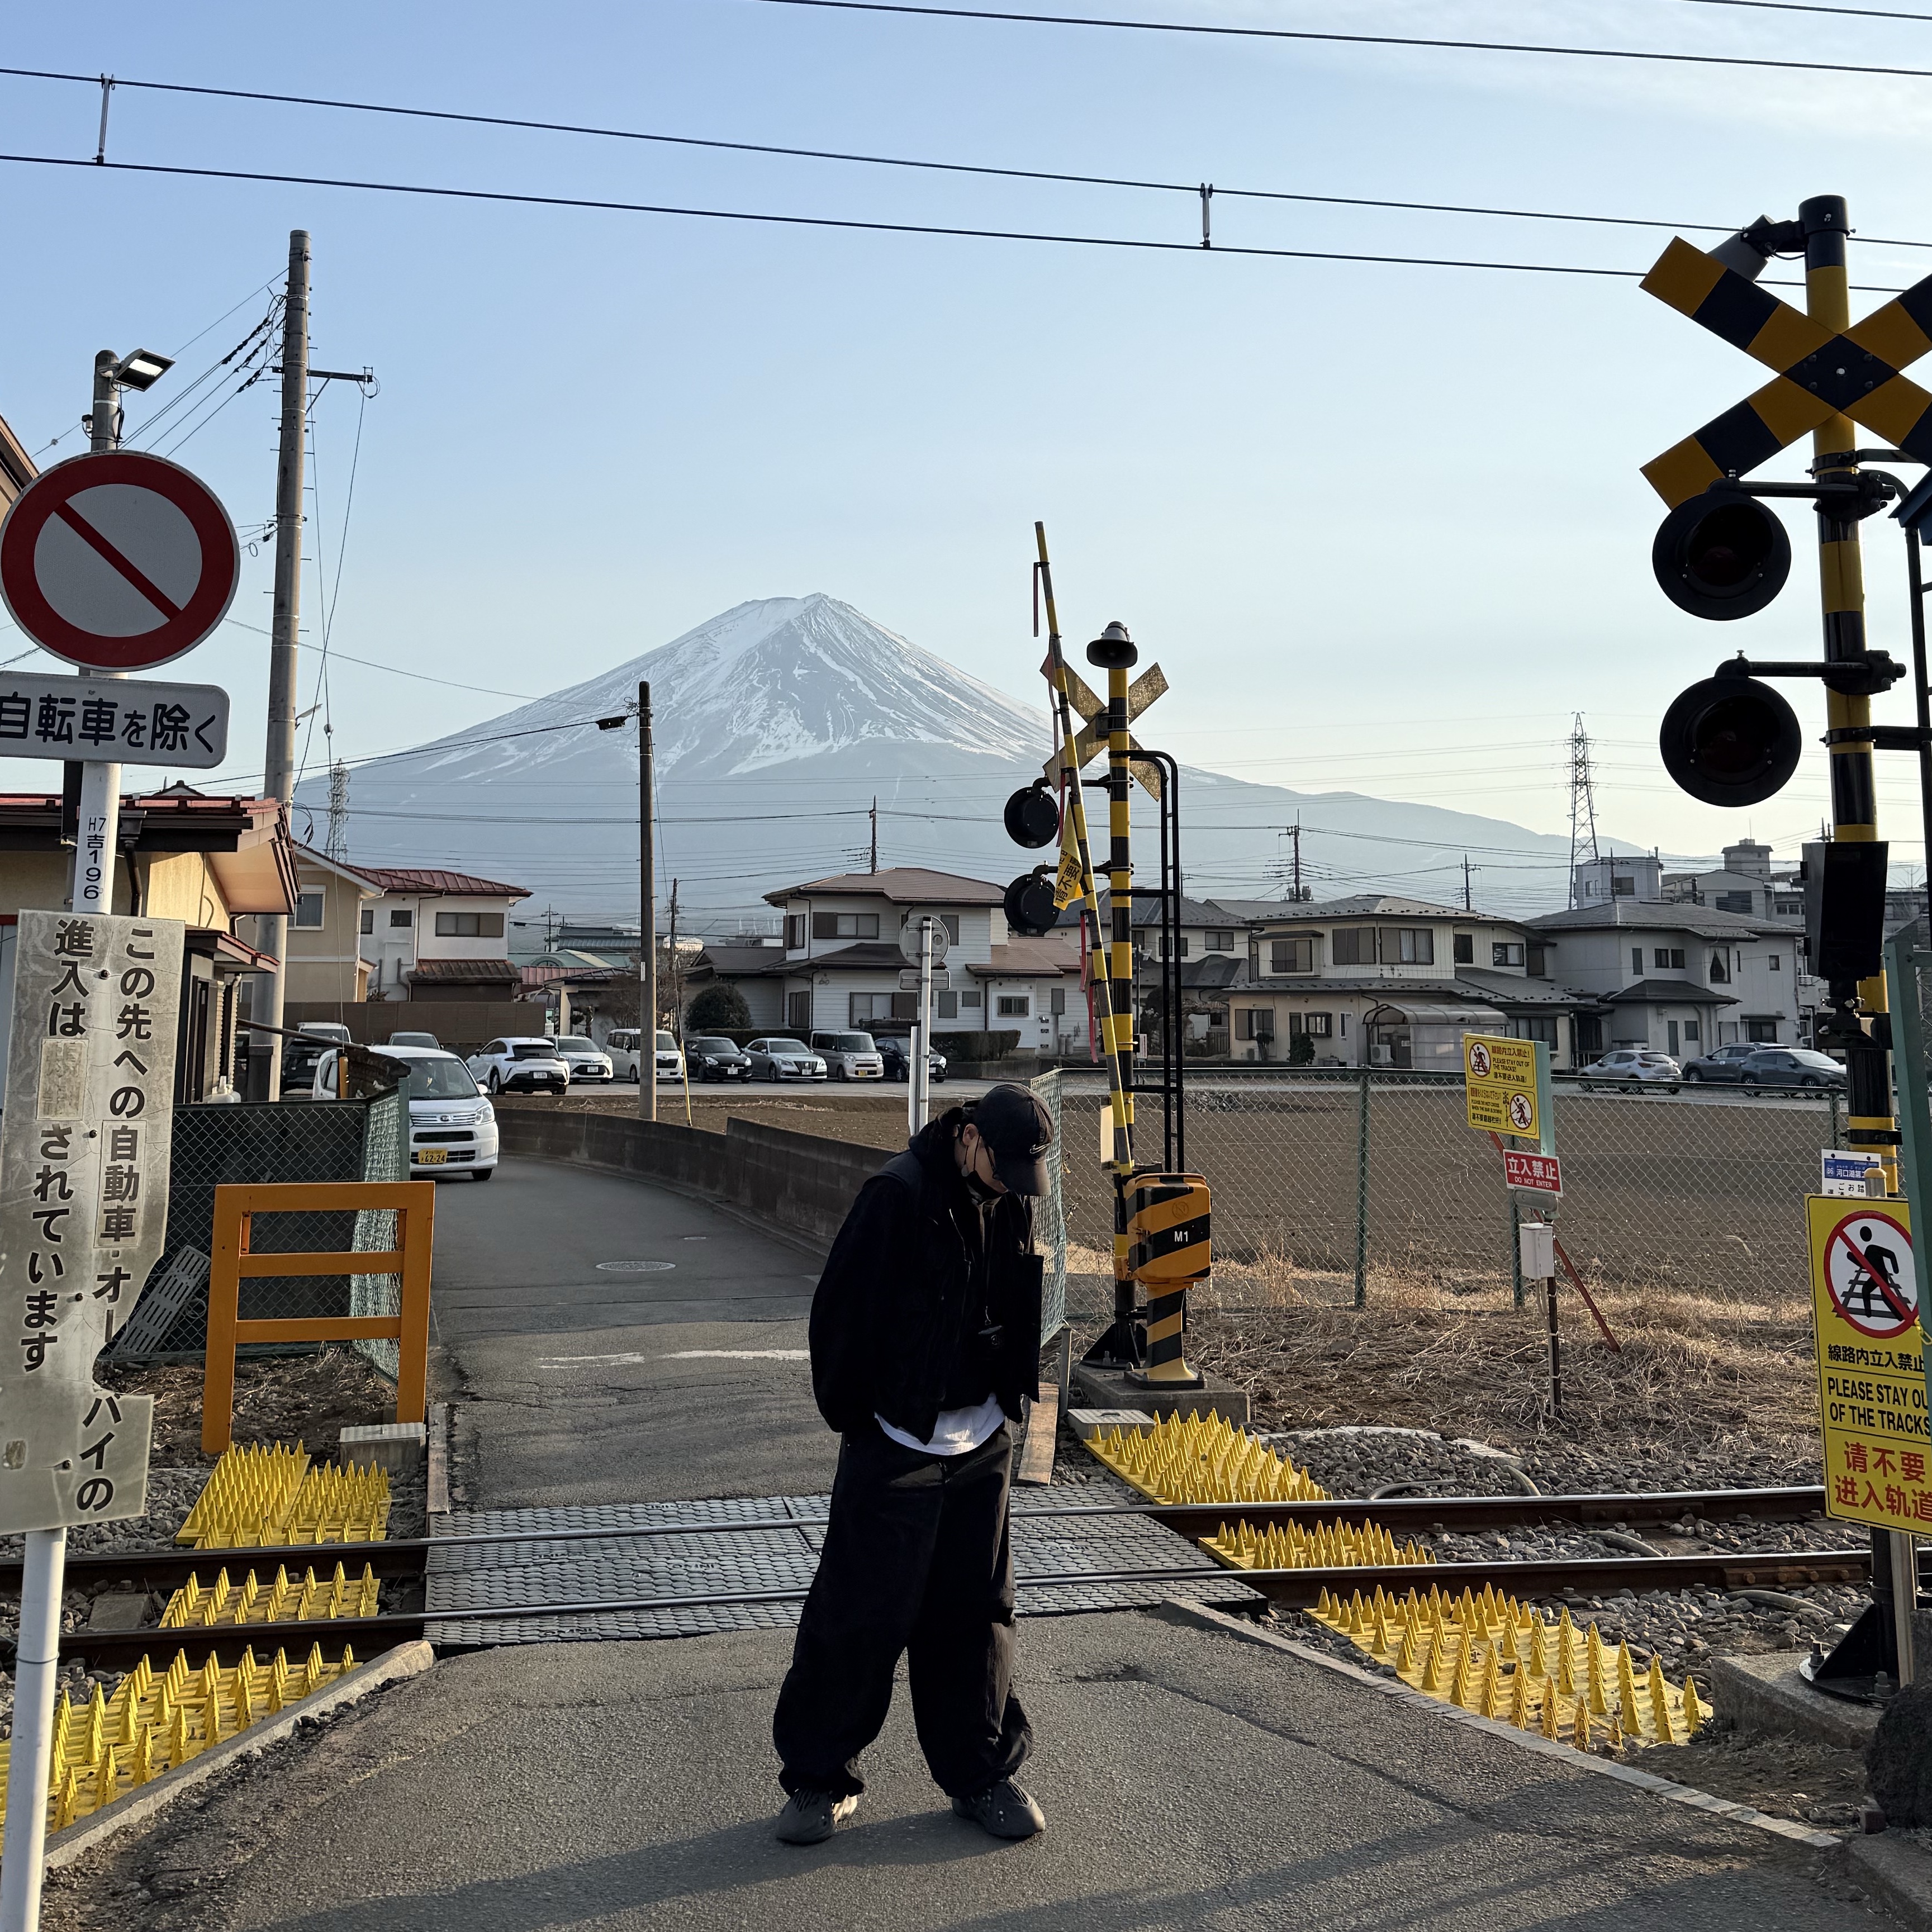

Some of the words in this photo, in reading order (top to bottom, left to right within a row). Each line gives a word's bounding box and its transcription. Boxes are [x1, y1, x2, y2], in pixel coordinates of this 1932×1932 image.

[0, 691, 216, 753] 自転車を除く
[88, 817, 107, 832] H7
[1508, 1157, 1557, 1180] 立入禁止
[1536, 1180, 1553, 1188] ENTER
[1174, 1231, 1188, 1242] M1
[1827, 1344, 1925, 1373] 線路内立入禁止
[1827, 1376, 1874, 1402] PLEASE
[1876, 1384, 1908, 1407] STAY
[1912, 1389, 1928, 1410] OU
[1830, 1402, 1845, 1422] OF
[1849, 1405, 1876, 1427] THE
[1878, 1409, 1931, 1437] TRACKS
[1844, 1441, 1926, 1484] 请不要
[1835, 1475, 1932, 1523] 进入轨道
